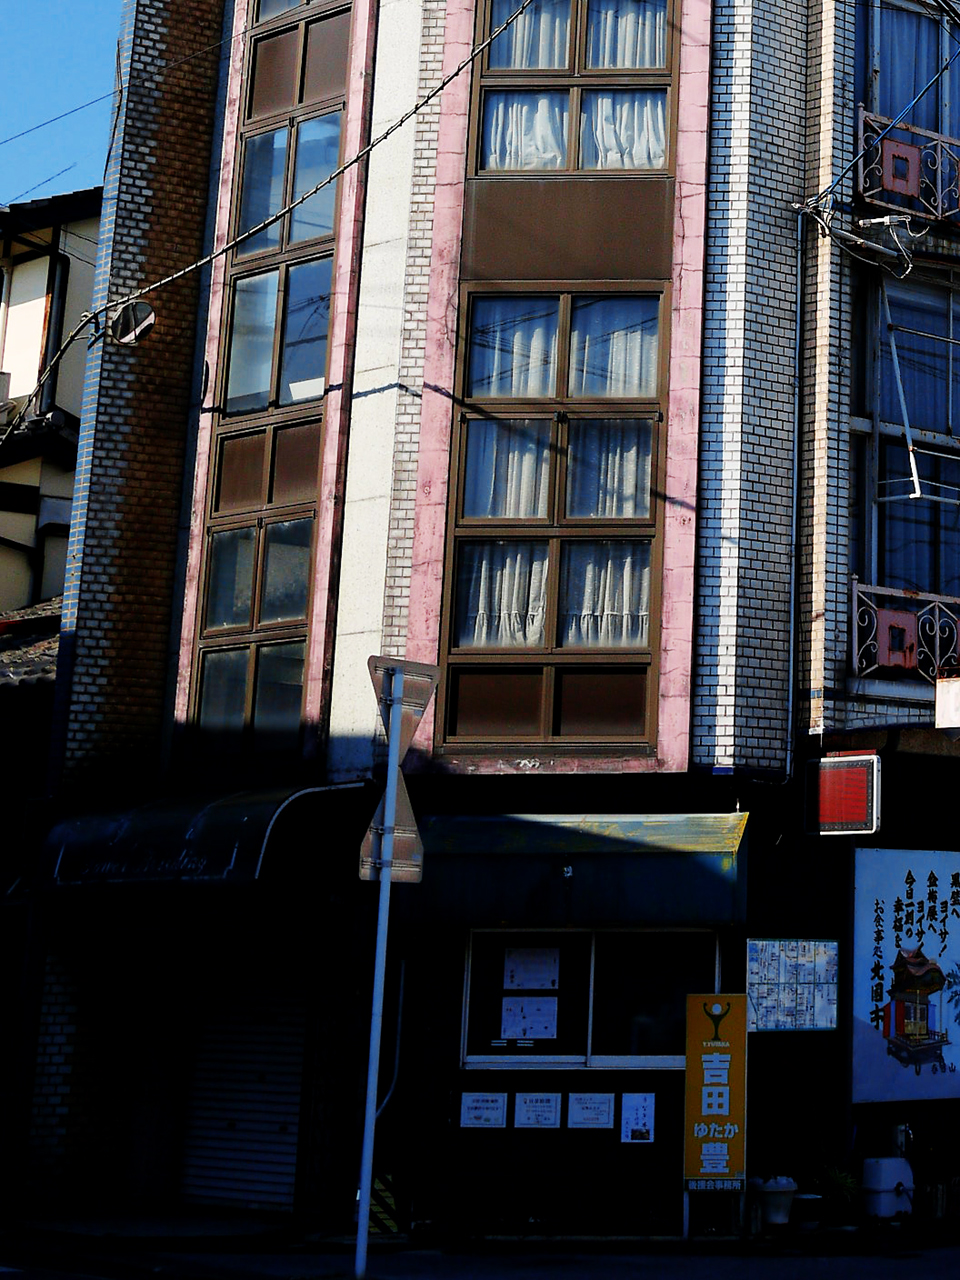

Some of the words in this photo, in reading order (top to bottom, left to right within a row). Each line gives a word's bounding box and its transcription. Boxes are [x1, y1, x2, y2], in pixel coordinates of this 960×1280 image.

[701, 1053, 732, 1116] 吉田
[693, 1122, 740, 1139] ゆたか
